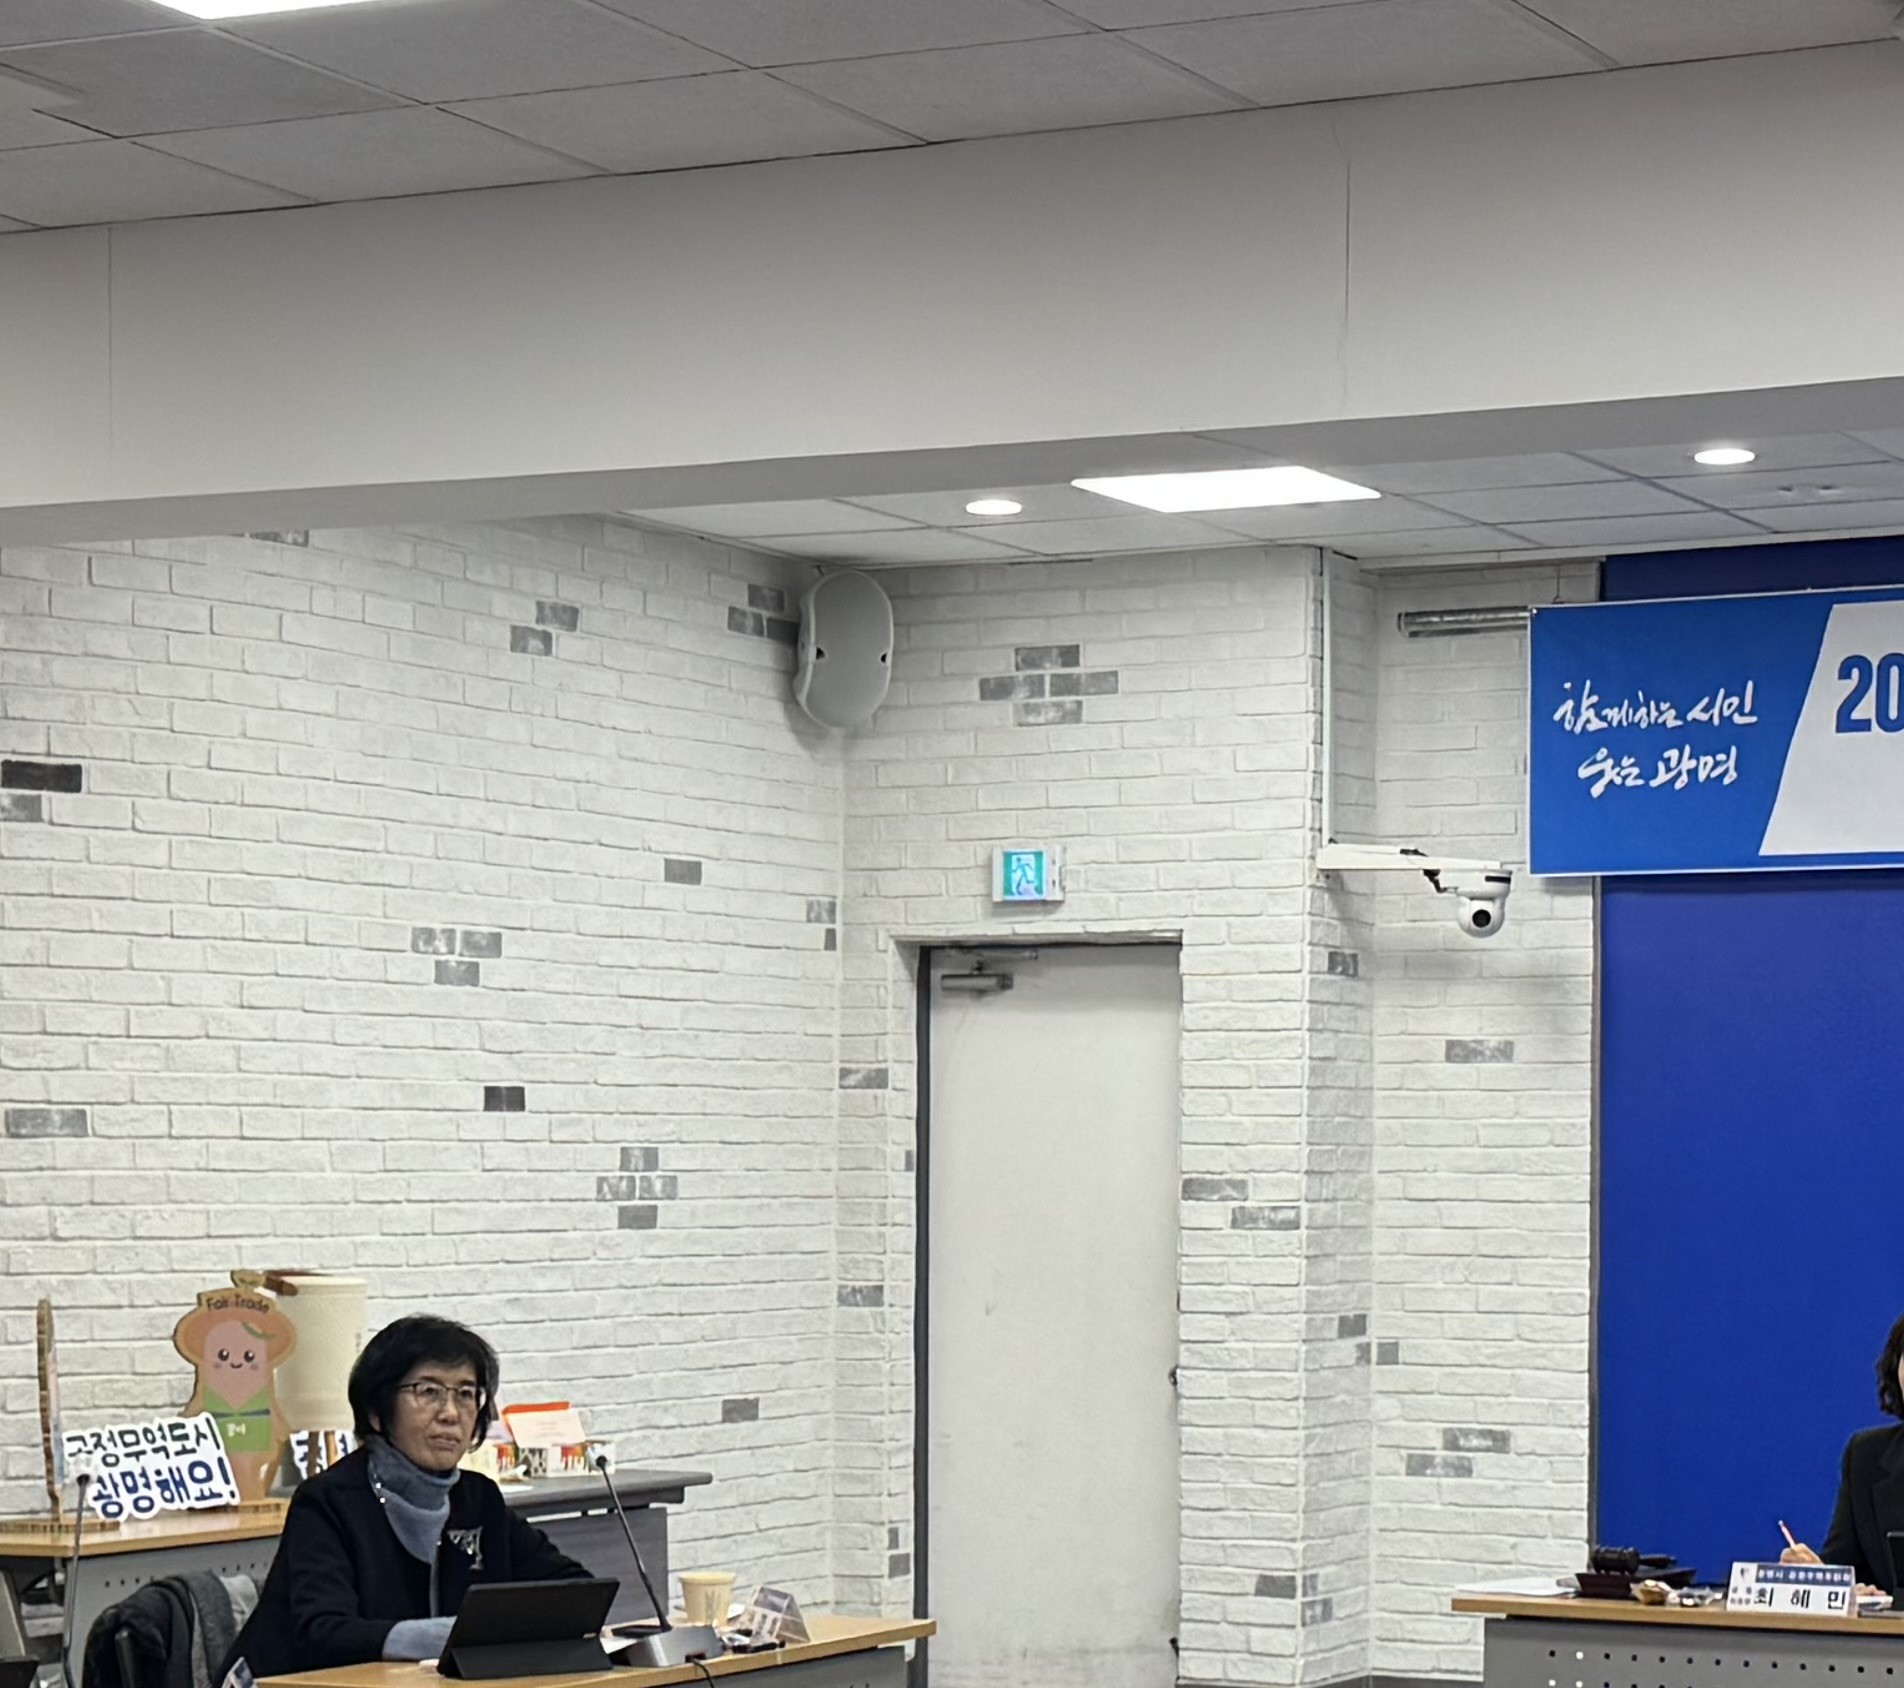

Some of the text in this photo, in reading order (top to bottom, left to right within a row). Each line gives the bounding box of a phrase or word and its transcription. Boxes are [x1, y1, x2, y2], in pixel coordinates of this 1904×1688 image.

[1686, 680, 1758, 727] 시민
[1649, 744, 1738, 790] 광명
[92, 1456, 236, 1519] 광명해요!
